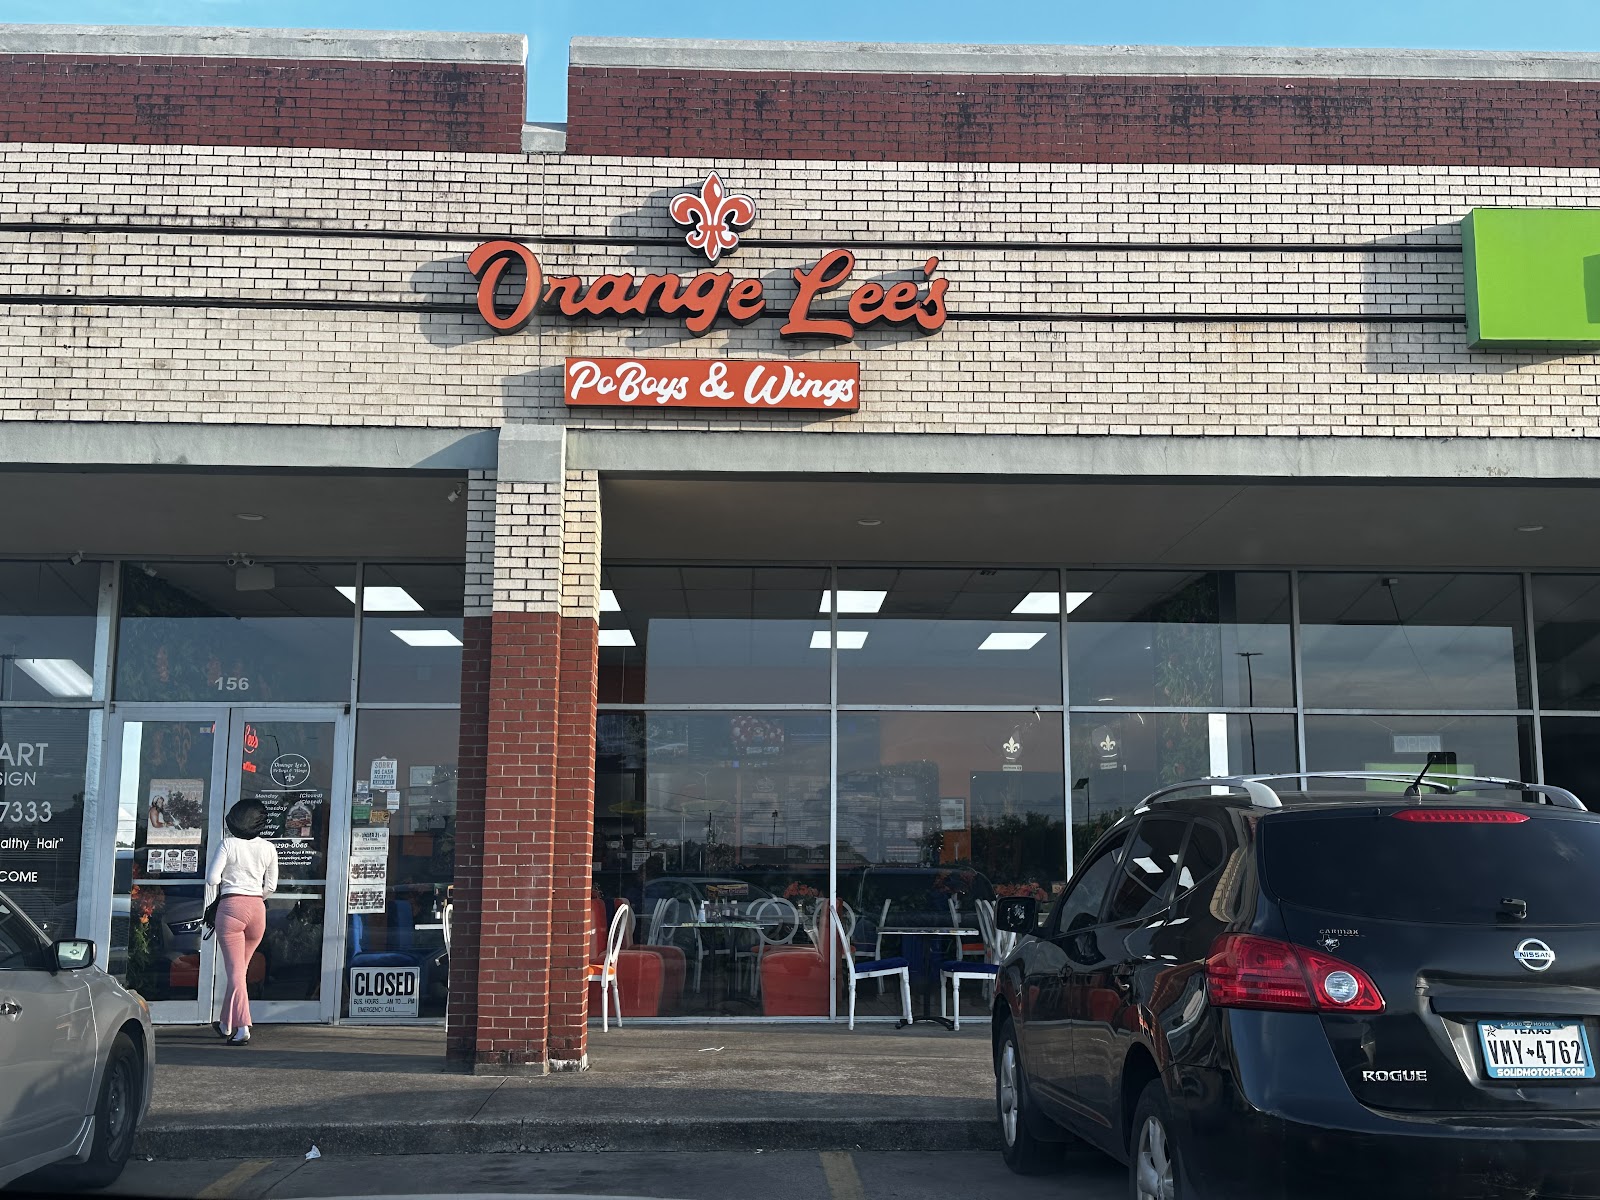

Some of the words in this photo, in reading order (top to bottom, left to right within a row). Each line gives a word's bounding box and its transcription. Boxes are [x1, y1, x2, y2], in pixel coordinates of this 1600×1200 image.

[466, 240, 765, 335] Orange
[780, 249, 950, 341] Lee's
[700, 362, 735, 399] &
[744, 365, 856, 406] Wings
[214, 676, 250, 691] 156
[0, 742, 49, 767] ART
[1393, 736, 1441, 753] OPEN
[374, 761, 394, 769] SORRY
[0, 801, 52, 823] 7333
[354, 972, 415, 997] CLOSED
[1487, 1040, 1523, 1065] VMY
[1536, 1040, 1584, 1065] 4762
[1362, 1069, 1428, 1082] ROGUE
[1496, 1068, 1585, 1077] SOLIDMOTORS.COM
